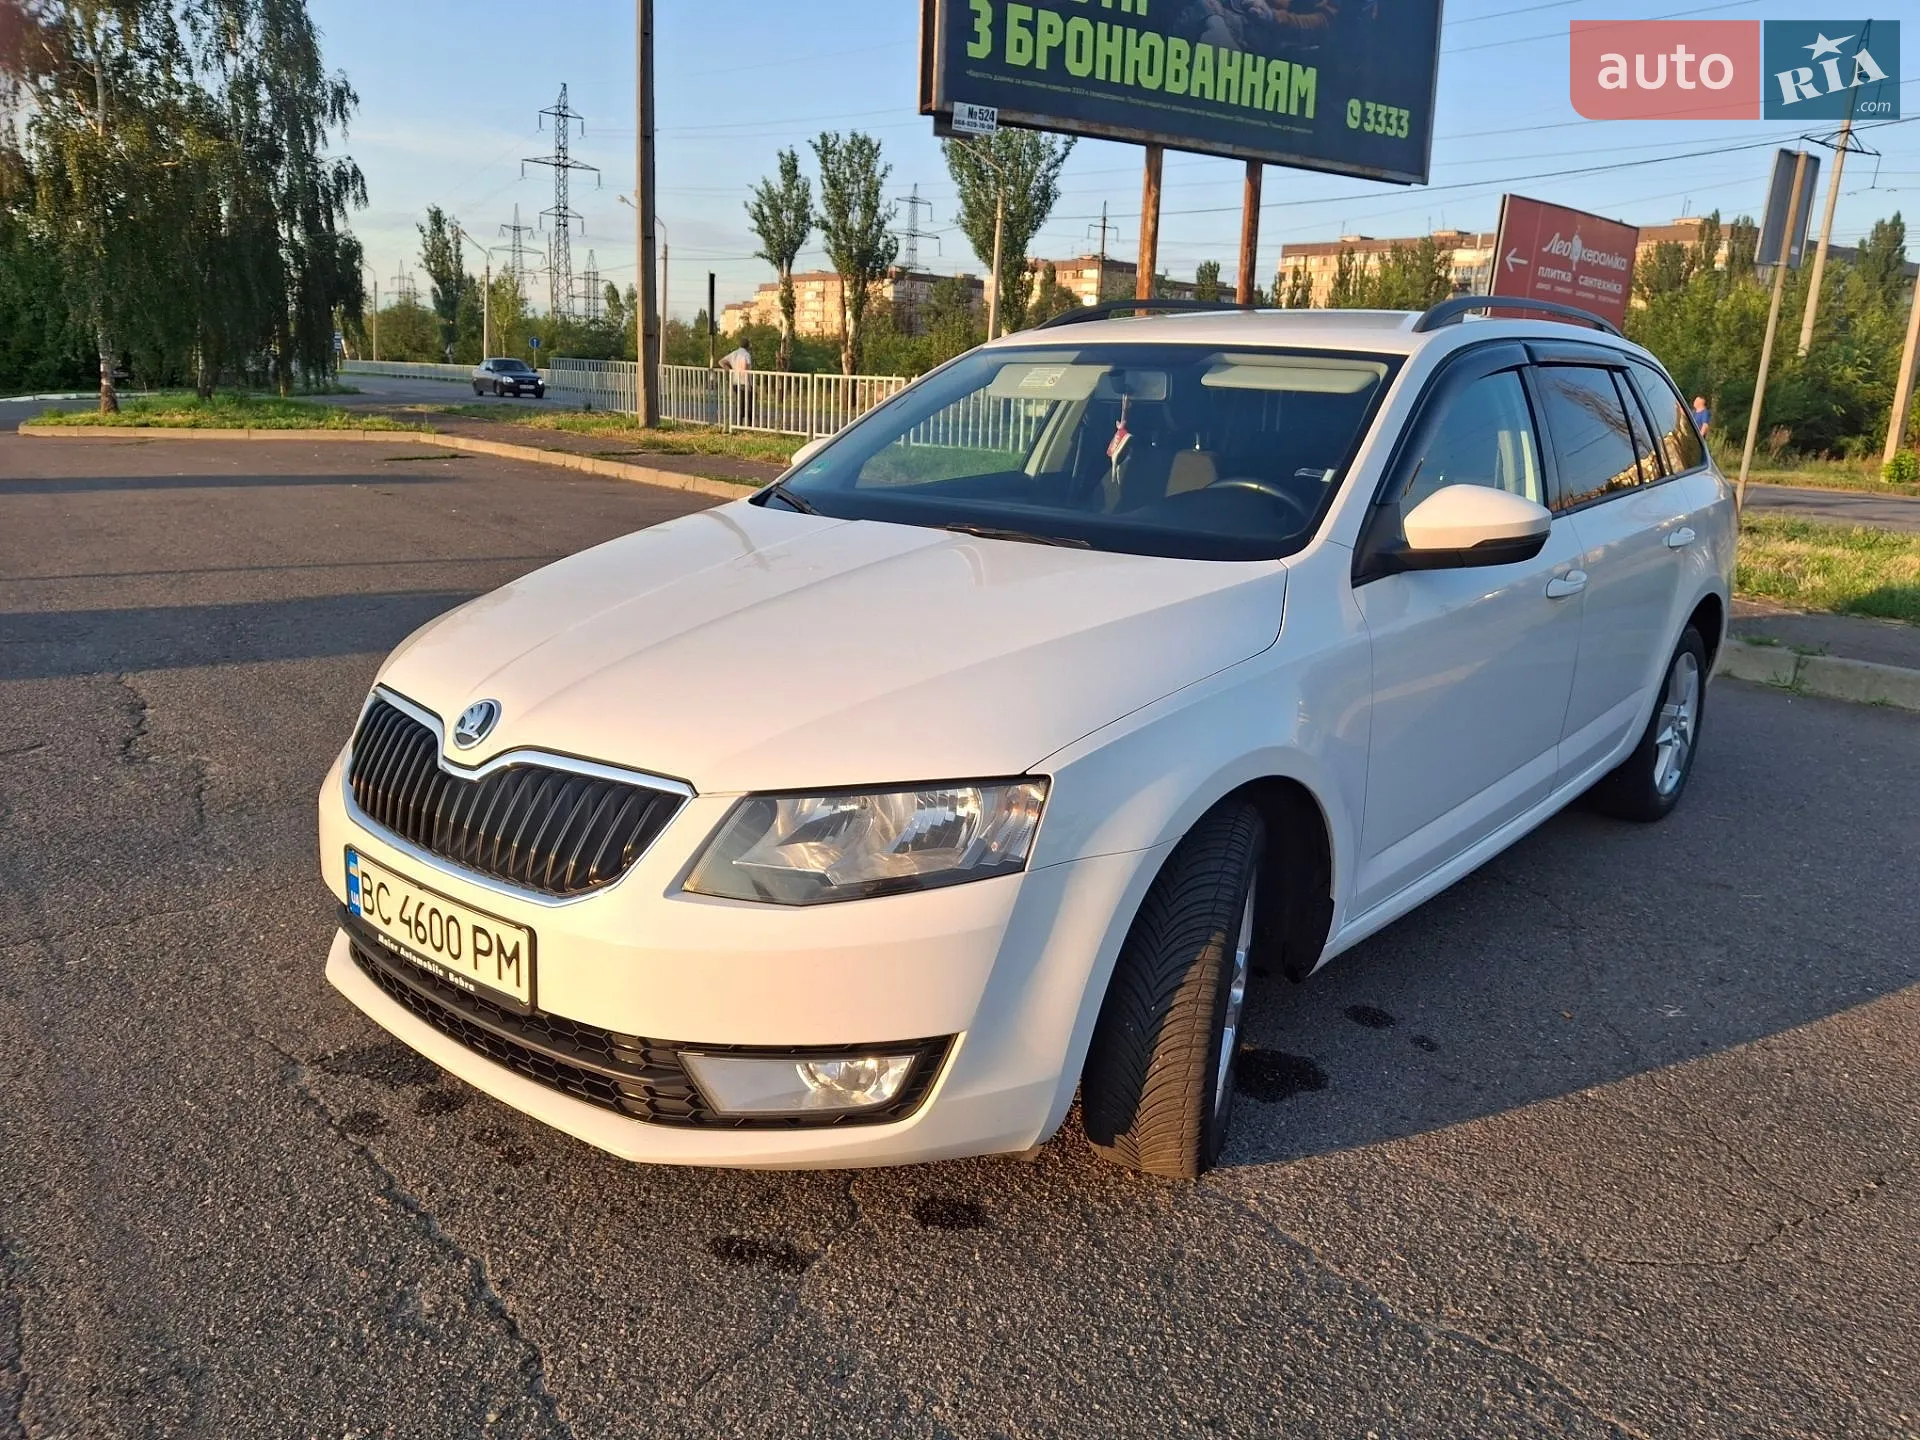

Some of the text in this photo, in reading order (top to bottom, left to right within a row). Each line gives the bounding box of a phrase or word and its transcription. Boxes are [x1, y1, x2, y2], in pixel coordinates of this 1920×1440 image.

[1005, 2, 1317, 119] БРОНЮВАННЯМ
[1363, 101, 1410, 138] 3333
[1537, 266, 1572, 282] плитка
[361, 870, 520, 988] BC 4600 PM
